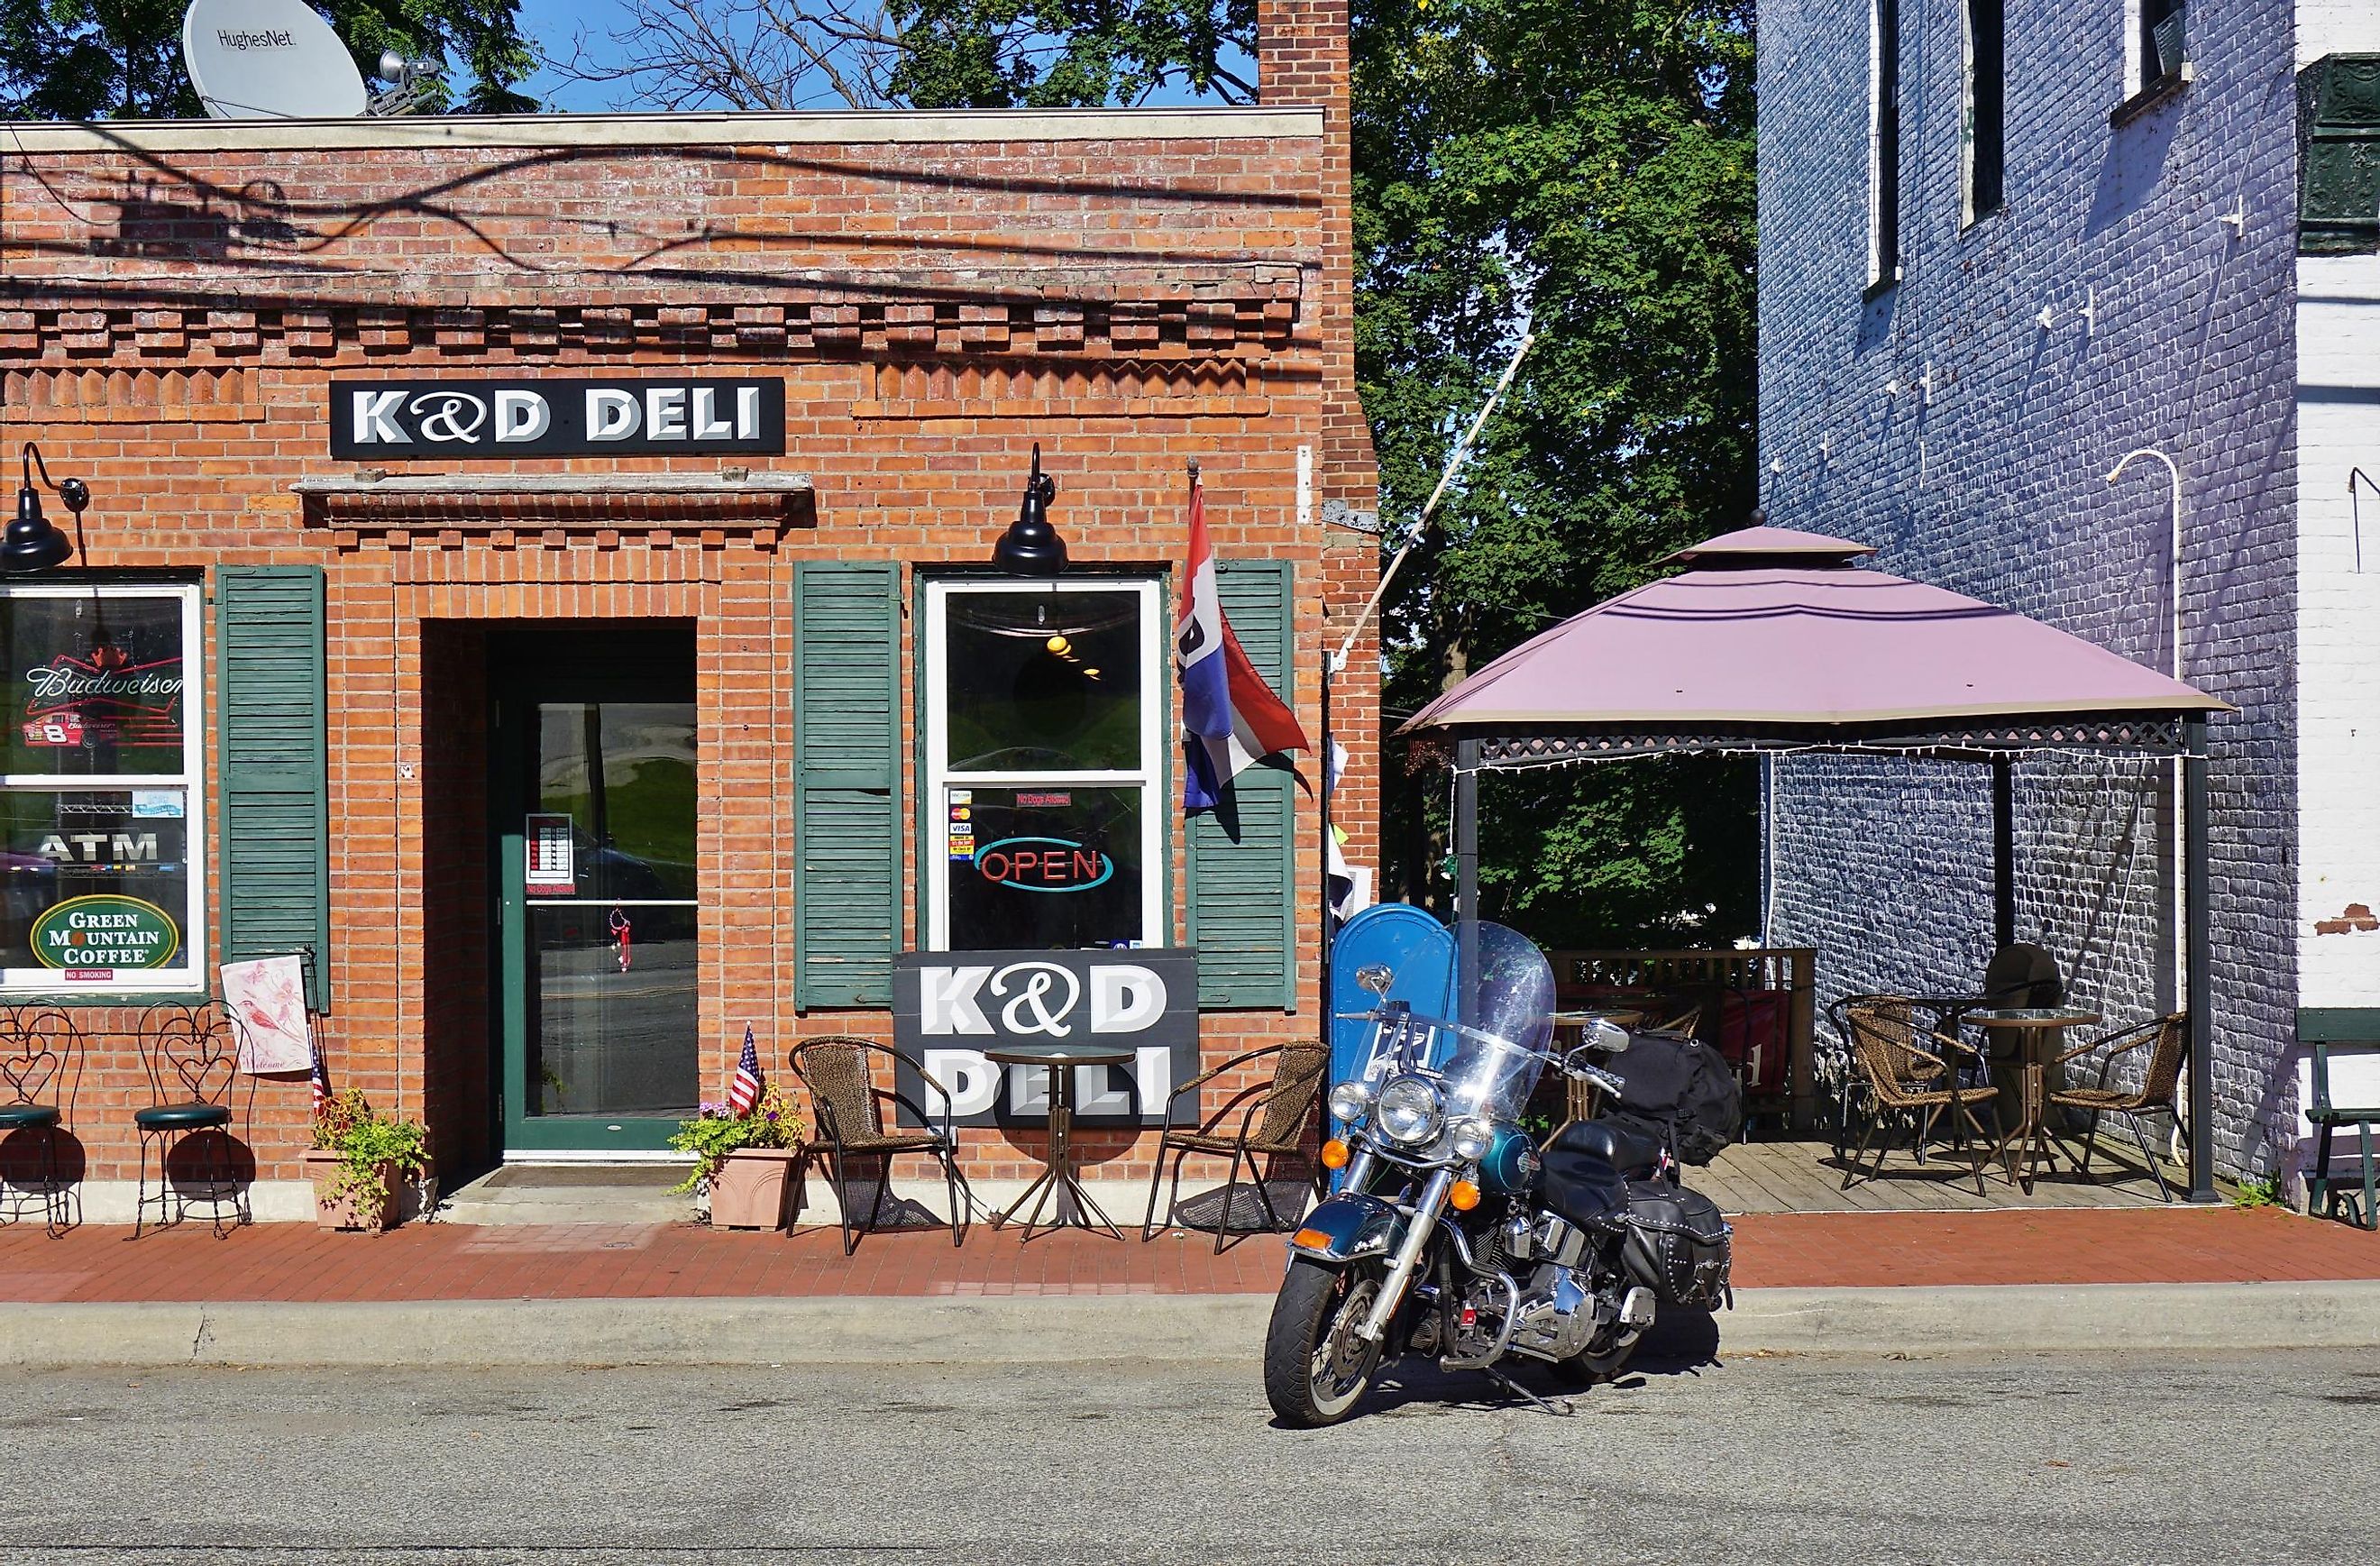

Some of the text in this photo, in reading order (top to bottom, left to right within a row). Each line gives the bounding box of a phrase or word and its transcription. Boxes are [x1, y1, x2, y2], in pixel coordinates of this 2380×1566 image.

[352, 387, 760, 444] K&D DELI
[26, 668, 184, 698] Budweiser
[43, 725, 68, 743] 8
[38, 833, 158, 862] ATM
[982, 850, 1097, 881] OPEN
[69, 912, 139, 929] GREEN
[66, 970, 112, 979] NO SMOKING
[920, 961, 1167, 1037] K&D
[924, 1047, 1171, 1117] DELI
